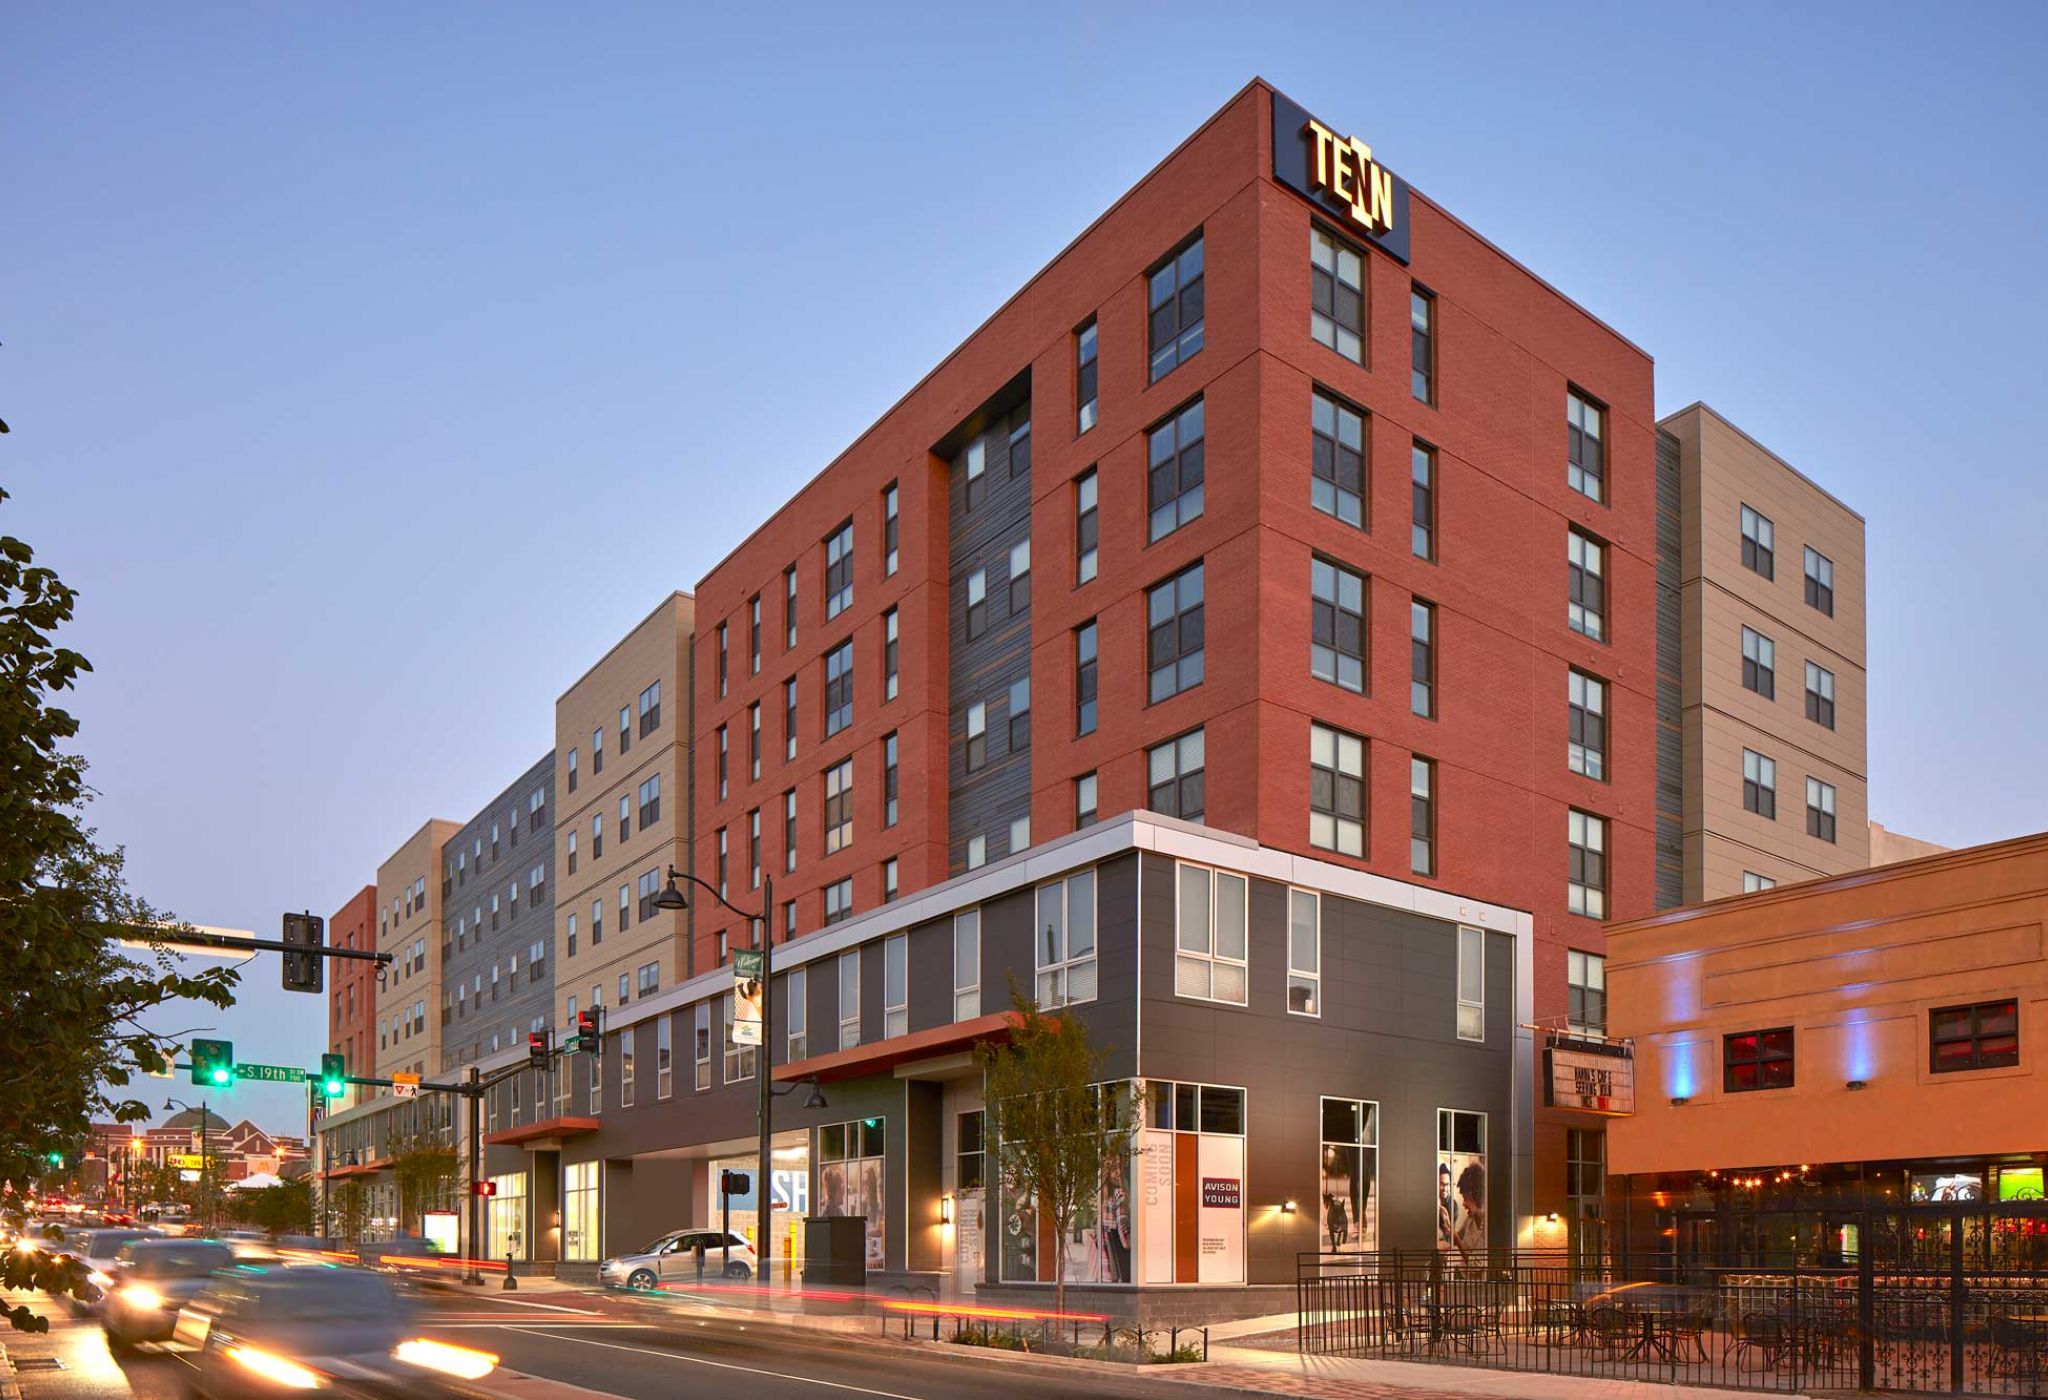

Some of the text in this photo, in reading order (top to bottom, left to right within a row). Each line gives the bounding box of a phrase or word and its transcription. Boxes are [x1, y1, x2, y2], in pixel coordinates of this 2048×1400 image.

[1308, 118, 1393, 231] TENN
[260, 1067, 286, 1080] 19th
[1145, 1143, 1158, 1206] COMING
[1159, 1144, 1171, 1186] SOON
[1204, 1182, 1239, 1192] AVISON
[1204, 1194, 1239, 1204] YOUNG
[960, 1208, 969, 1264] COMING
